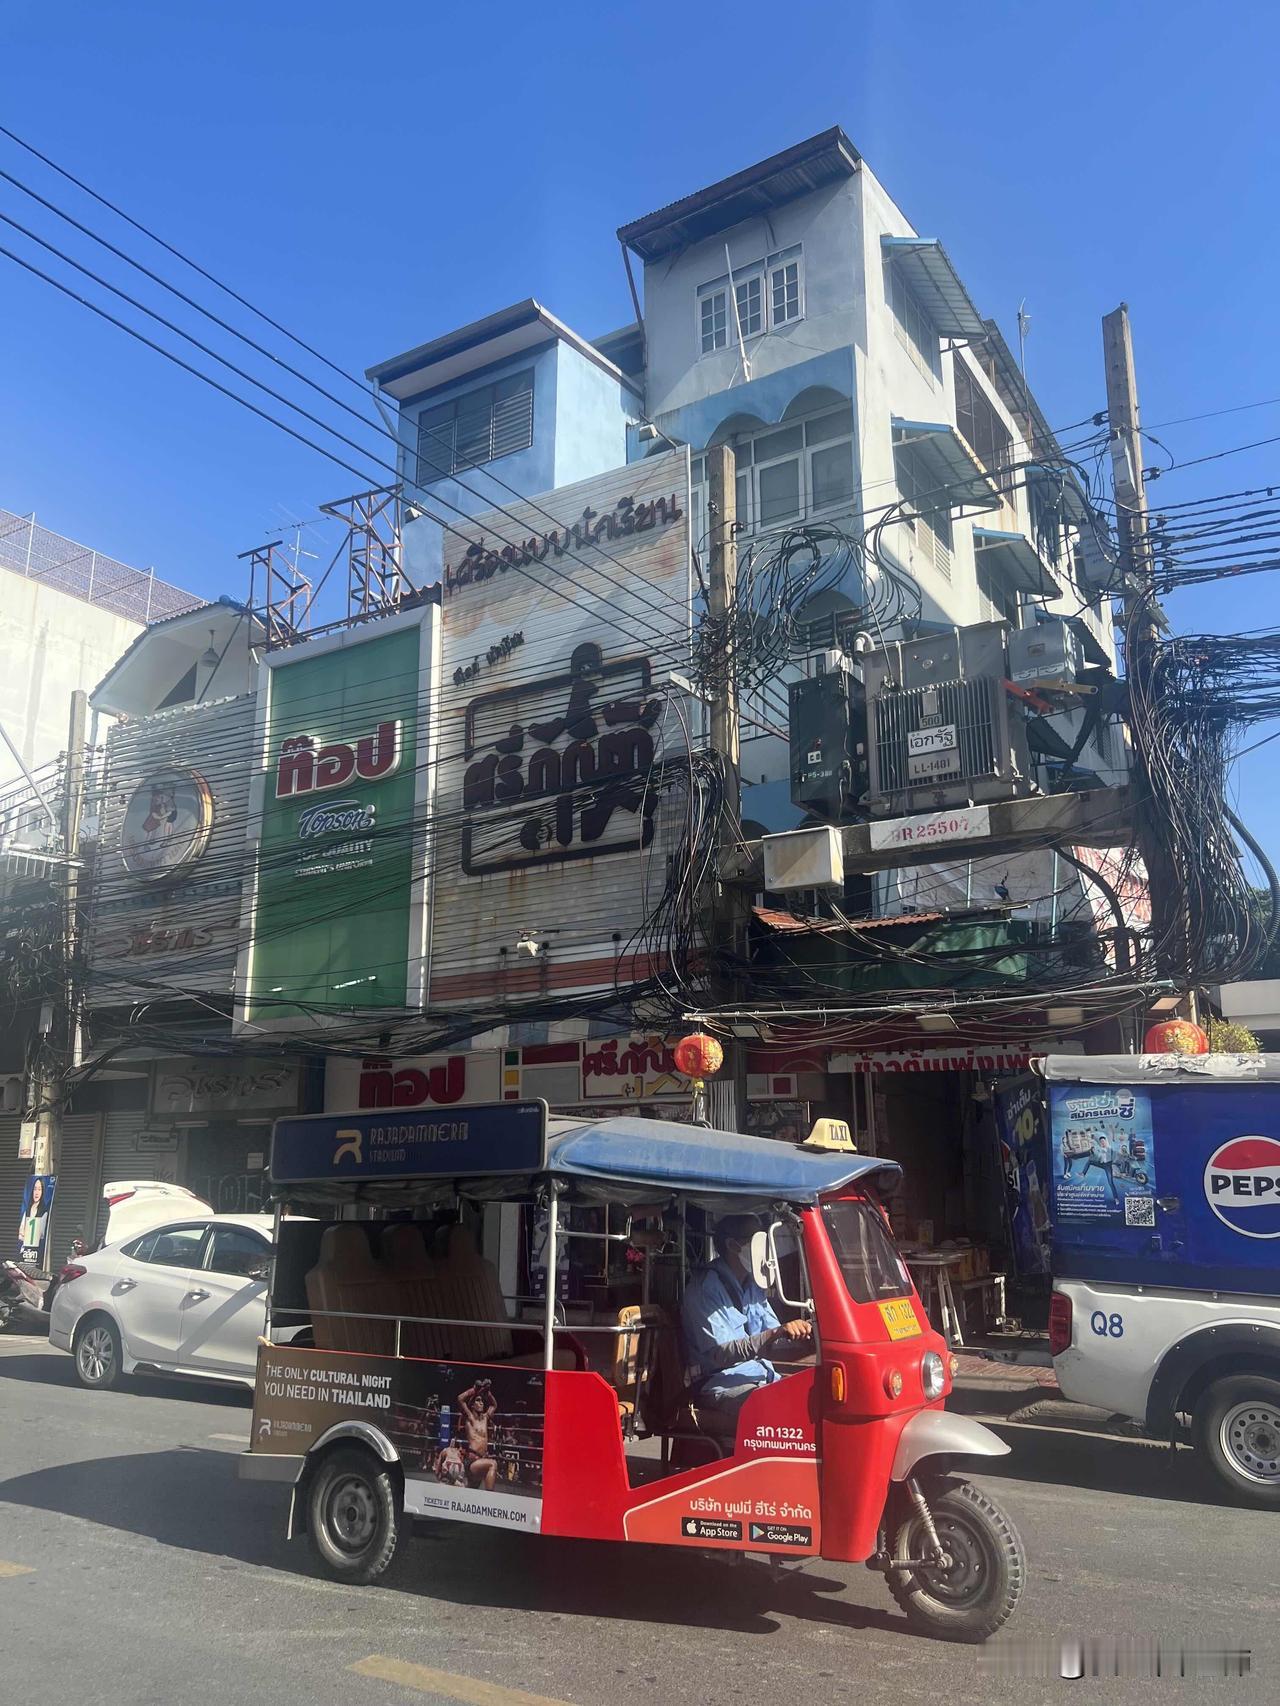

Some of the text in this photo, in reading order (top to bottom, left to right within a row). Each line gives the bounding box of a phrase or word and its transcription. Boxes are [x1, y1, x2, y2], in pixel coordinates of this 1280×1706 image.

[910, 728, 954, 749] เอกรัฐ
[829, 1124, 848, 1141] TAXI
[28, 1218, 36, 1245] 1
[1090, 1310, 1124, 1338] Q8
[266, 1361, 392, 1390] THE ONLY CULTURAL NIGHT
[264, 1381, 391, 1409] YOU NEED IN THAILAND
[756, 1425, 804, 1440] สก 1322
[743, 1439, 817, 1452] กรุงเทพมหานคร
[451, 1501, 527, 1523] RAJADAMNERN.COM
[690, 1497, 812, 1519] บริษัท มูฟมี ฮีโร่ จำกัด
[700, 1526, 738, 1538] App Store
[767, 1532, 809, 1544] Google Play
